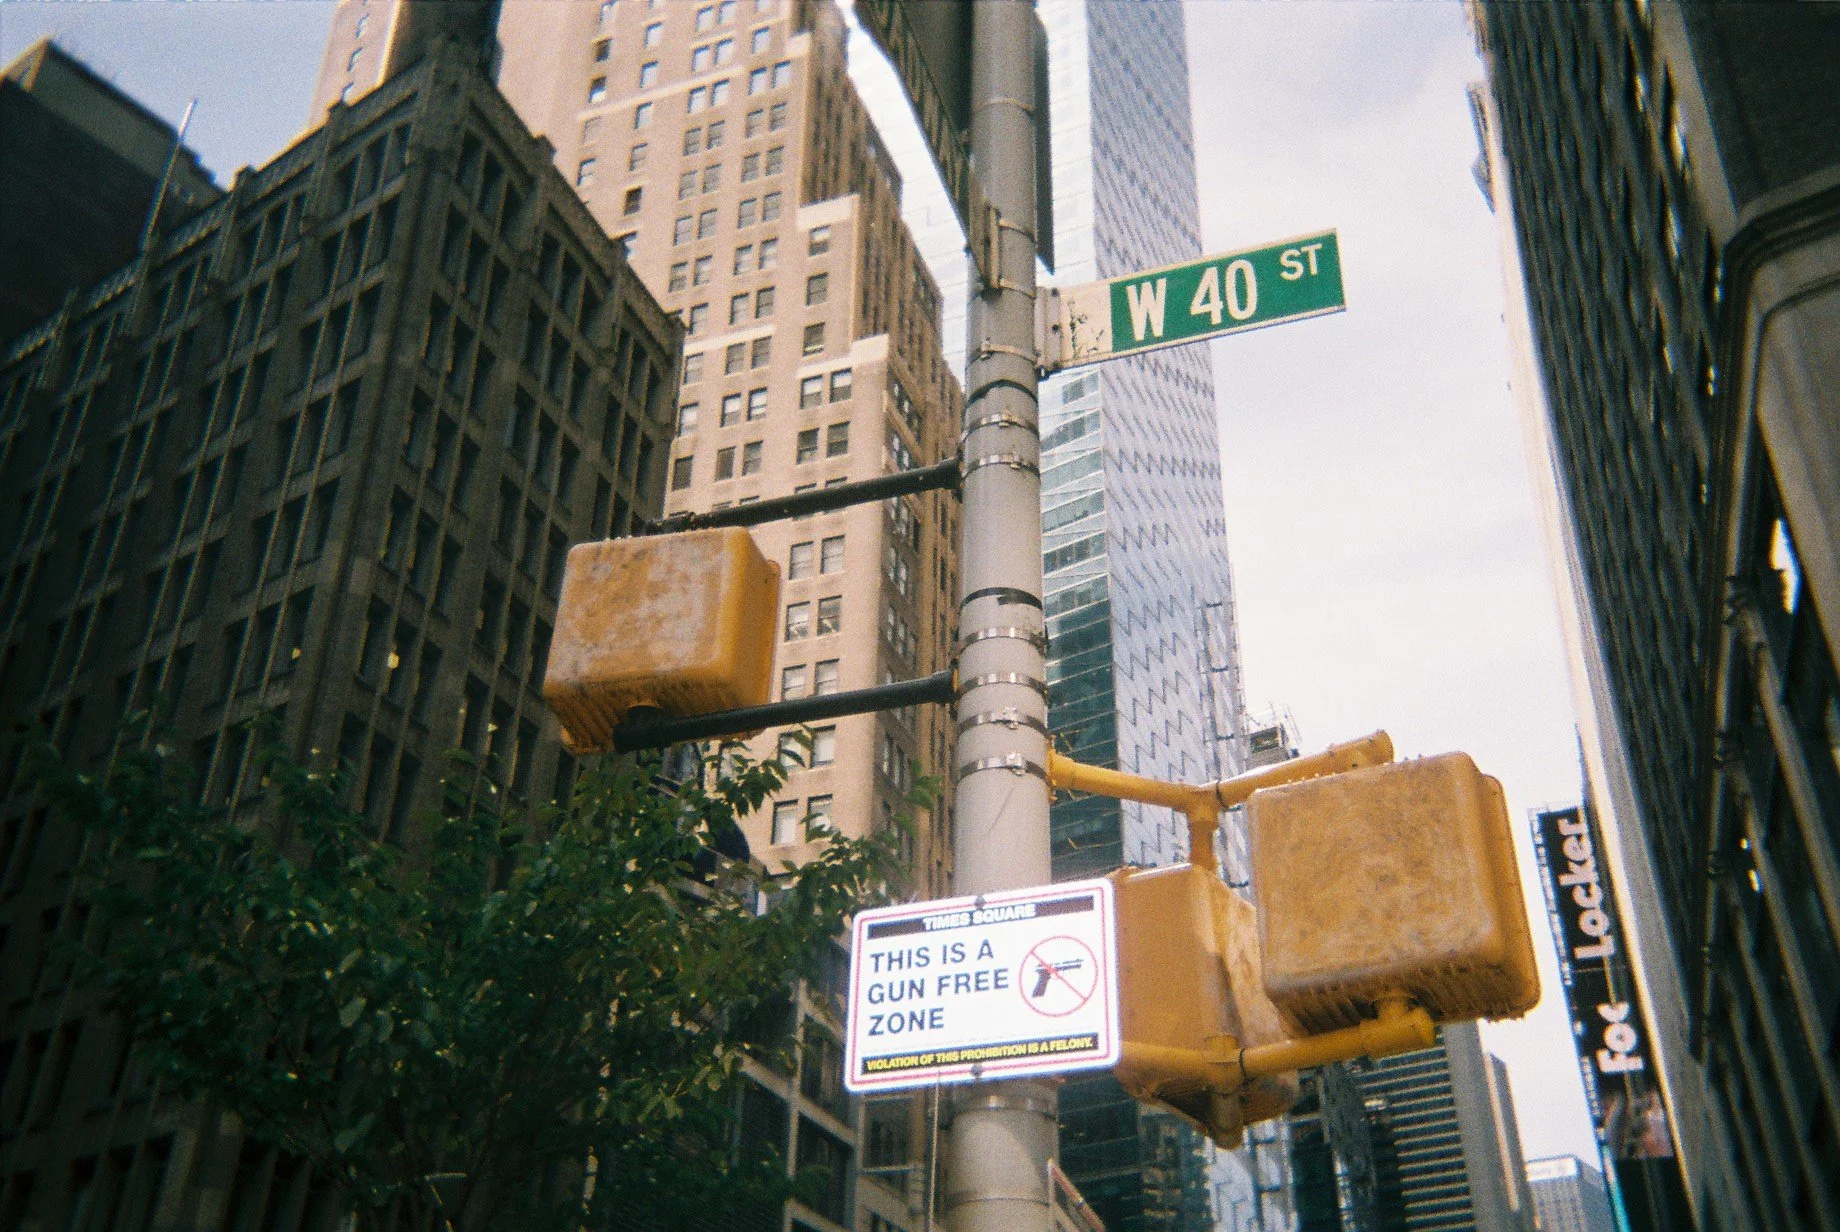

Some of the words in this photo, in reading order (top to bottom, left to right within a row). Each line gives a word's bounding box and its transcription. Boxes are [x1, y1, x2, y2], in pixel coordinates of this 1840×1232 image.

[1125, 277, 1167, 342] W
[1189, 259, 1258, 326] 40
[1279, 243, 1323, 281] ST
[1557, 814, 1616, 960] Locker
[923, 913, 971, 931] TIMES
[972, 903, 1036, 924] SQUARE
[870, 946, 931, 974] THIS
[942, 942, 966, 965] IS
[977, 939, 994, 961] A
[868, 977, 925, 1005] GUN
[936, 967, 1010, 997] FREE
[868, 1007, 945, 1037] ZONE
[867, 1053, 918, 1070] VIOLATION
[919, 1051, 934, 1065] OF
[934, 1049, 959, 1063] THIS
[960, 1043, 1027, 1061] PROHIBITION
[1028, 1041, 1039, 1054] IS
[1038, 1041, 1049, 1052] A
[1049, 1036, 1093, 1051] FELONY.
